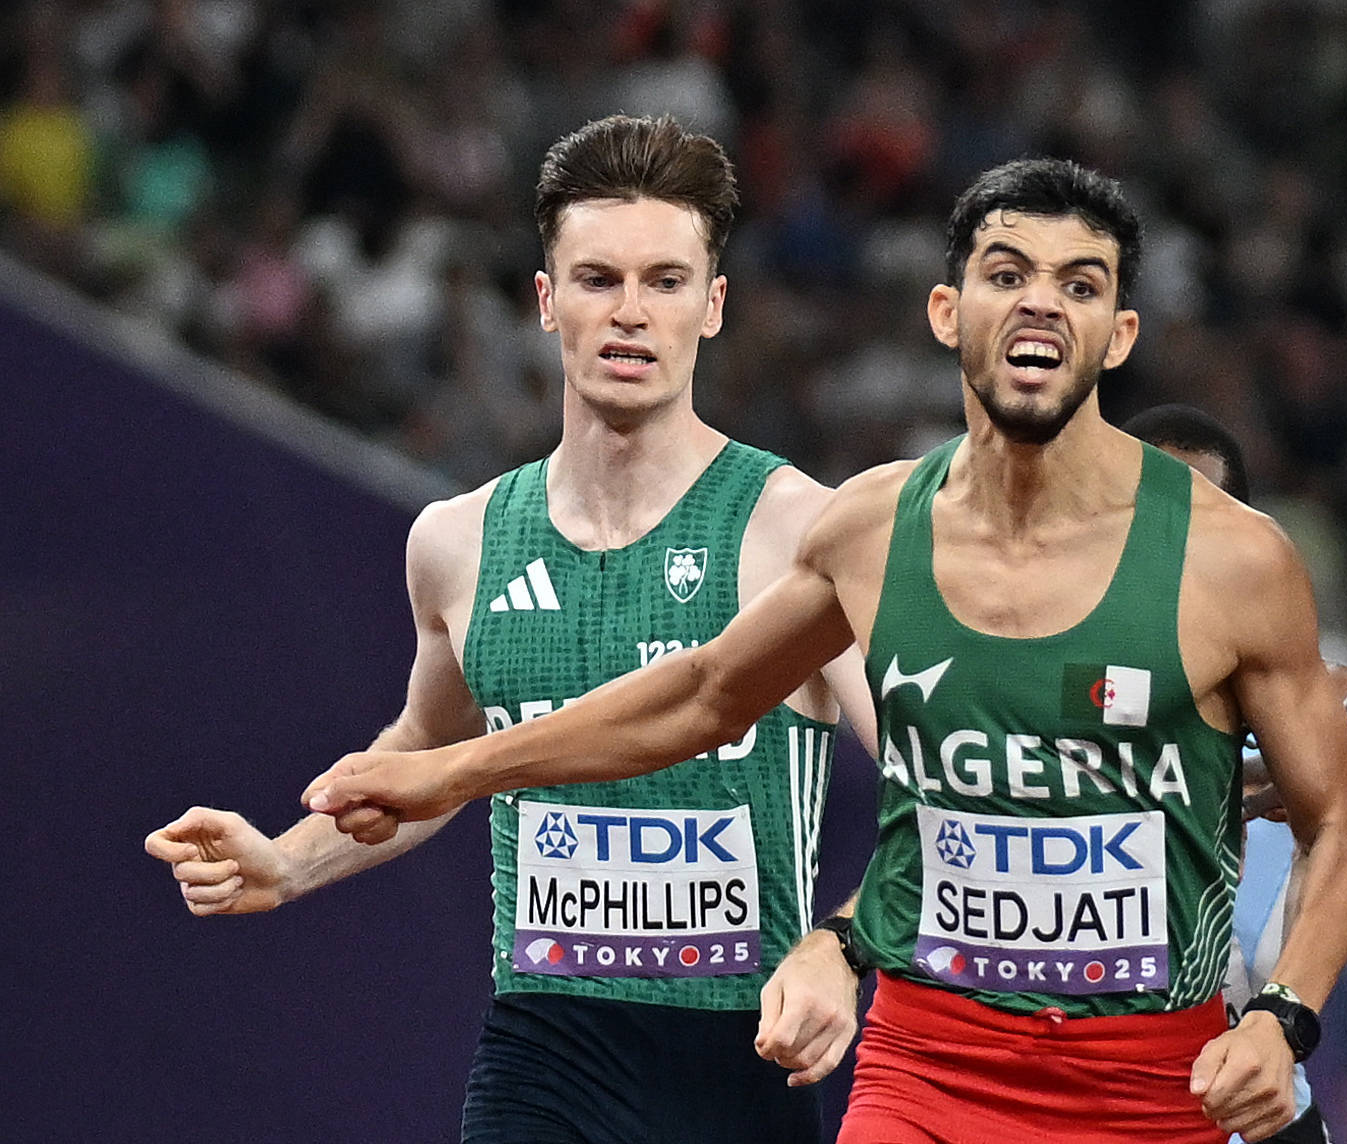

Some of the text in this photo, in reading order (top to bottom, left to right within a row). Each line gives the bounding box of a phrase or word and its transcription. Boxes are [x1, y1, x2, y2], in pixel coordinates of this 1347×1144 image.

[882, 726, 1191, 806] ALGERIA
[577, 815, 739, 863] TDK
[975, 822, 1145, 875] TDK
[528, 875, 748, 930] McPHILLIPS
[935, 880, 1150, 943] SEDJATI
